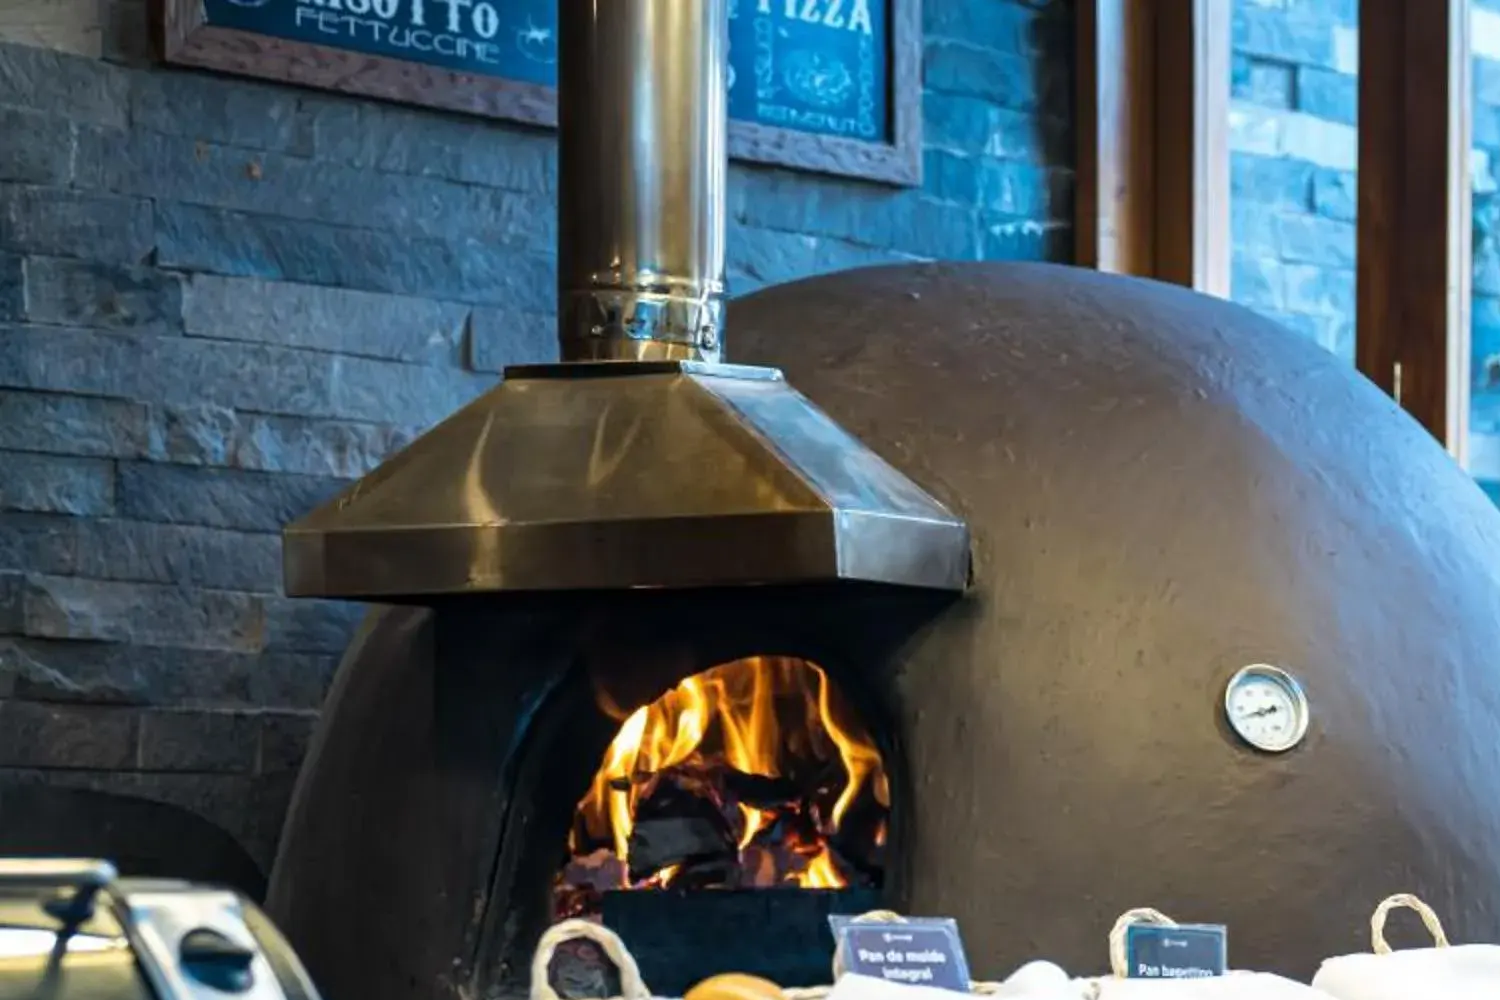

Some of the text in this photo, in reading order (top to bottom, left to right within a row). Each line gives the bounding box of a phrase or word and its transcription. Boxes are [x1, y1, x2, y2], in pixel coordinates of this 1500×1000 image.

[296, 6, 499, 64] FETTUCCINE
[858, 949, 884, 963] Pan
[886, 949, 904, 963] de
[1138, 963, 1160, 977] Pan
